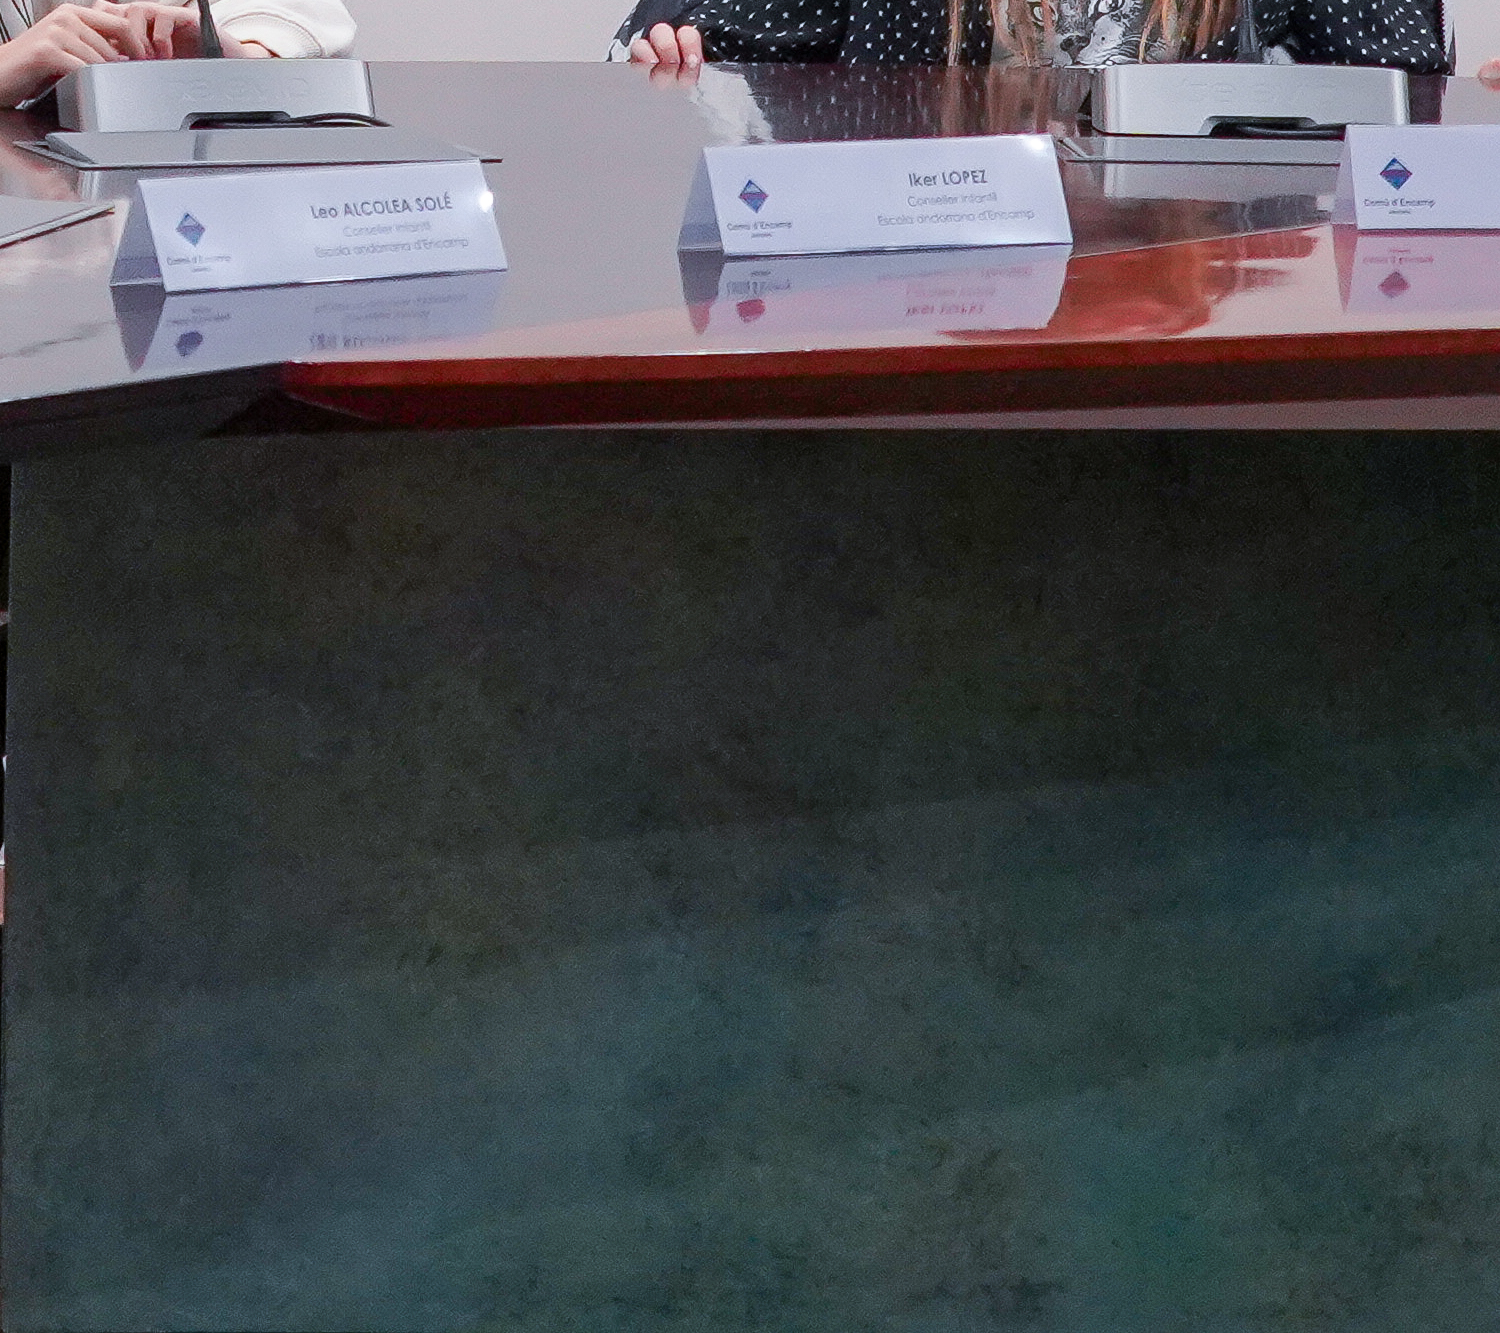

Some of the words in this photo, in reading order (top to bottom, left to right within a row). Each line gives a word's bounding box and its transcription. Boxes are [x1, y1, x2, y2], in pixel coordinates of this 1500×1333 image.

[908, 173, 938, 188] Iker
[311, 205, 338, 219] Leo
[344, 199, 413, 218] ALCOLEA
[415, 191, 453, 212] SOLÉ
